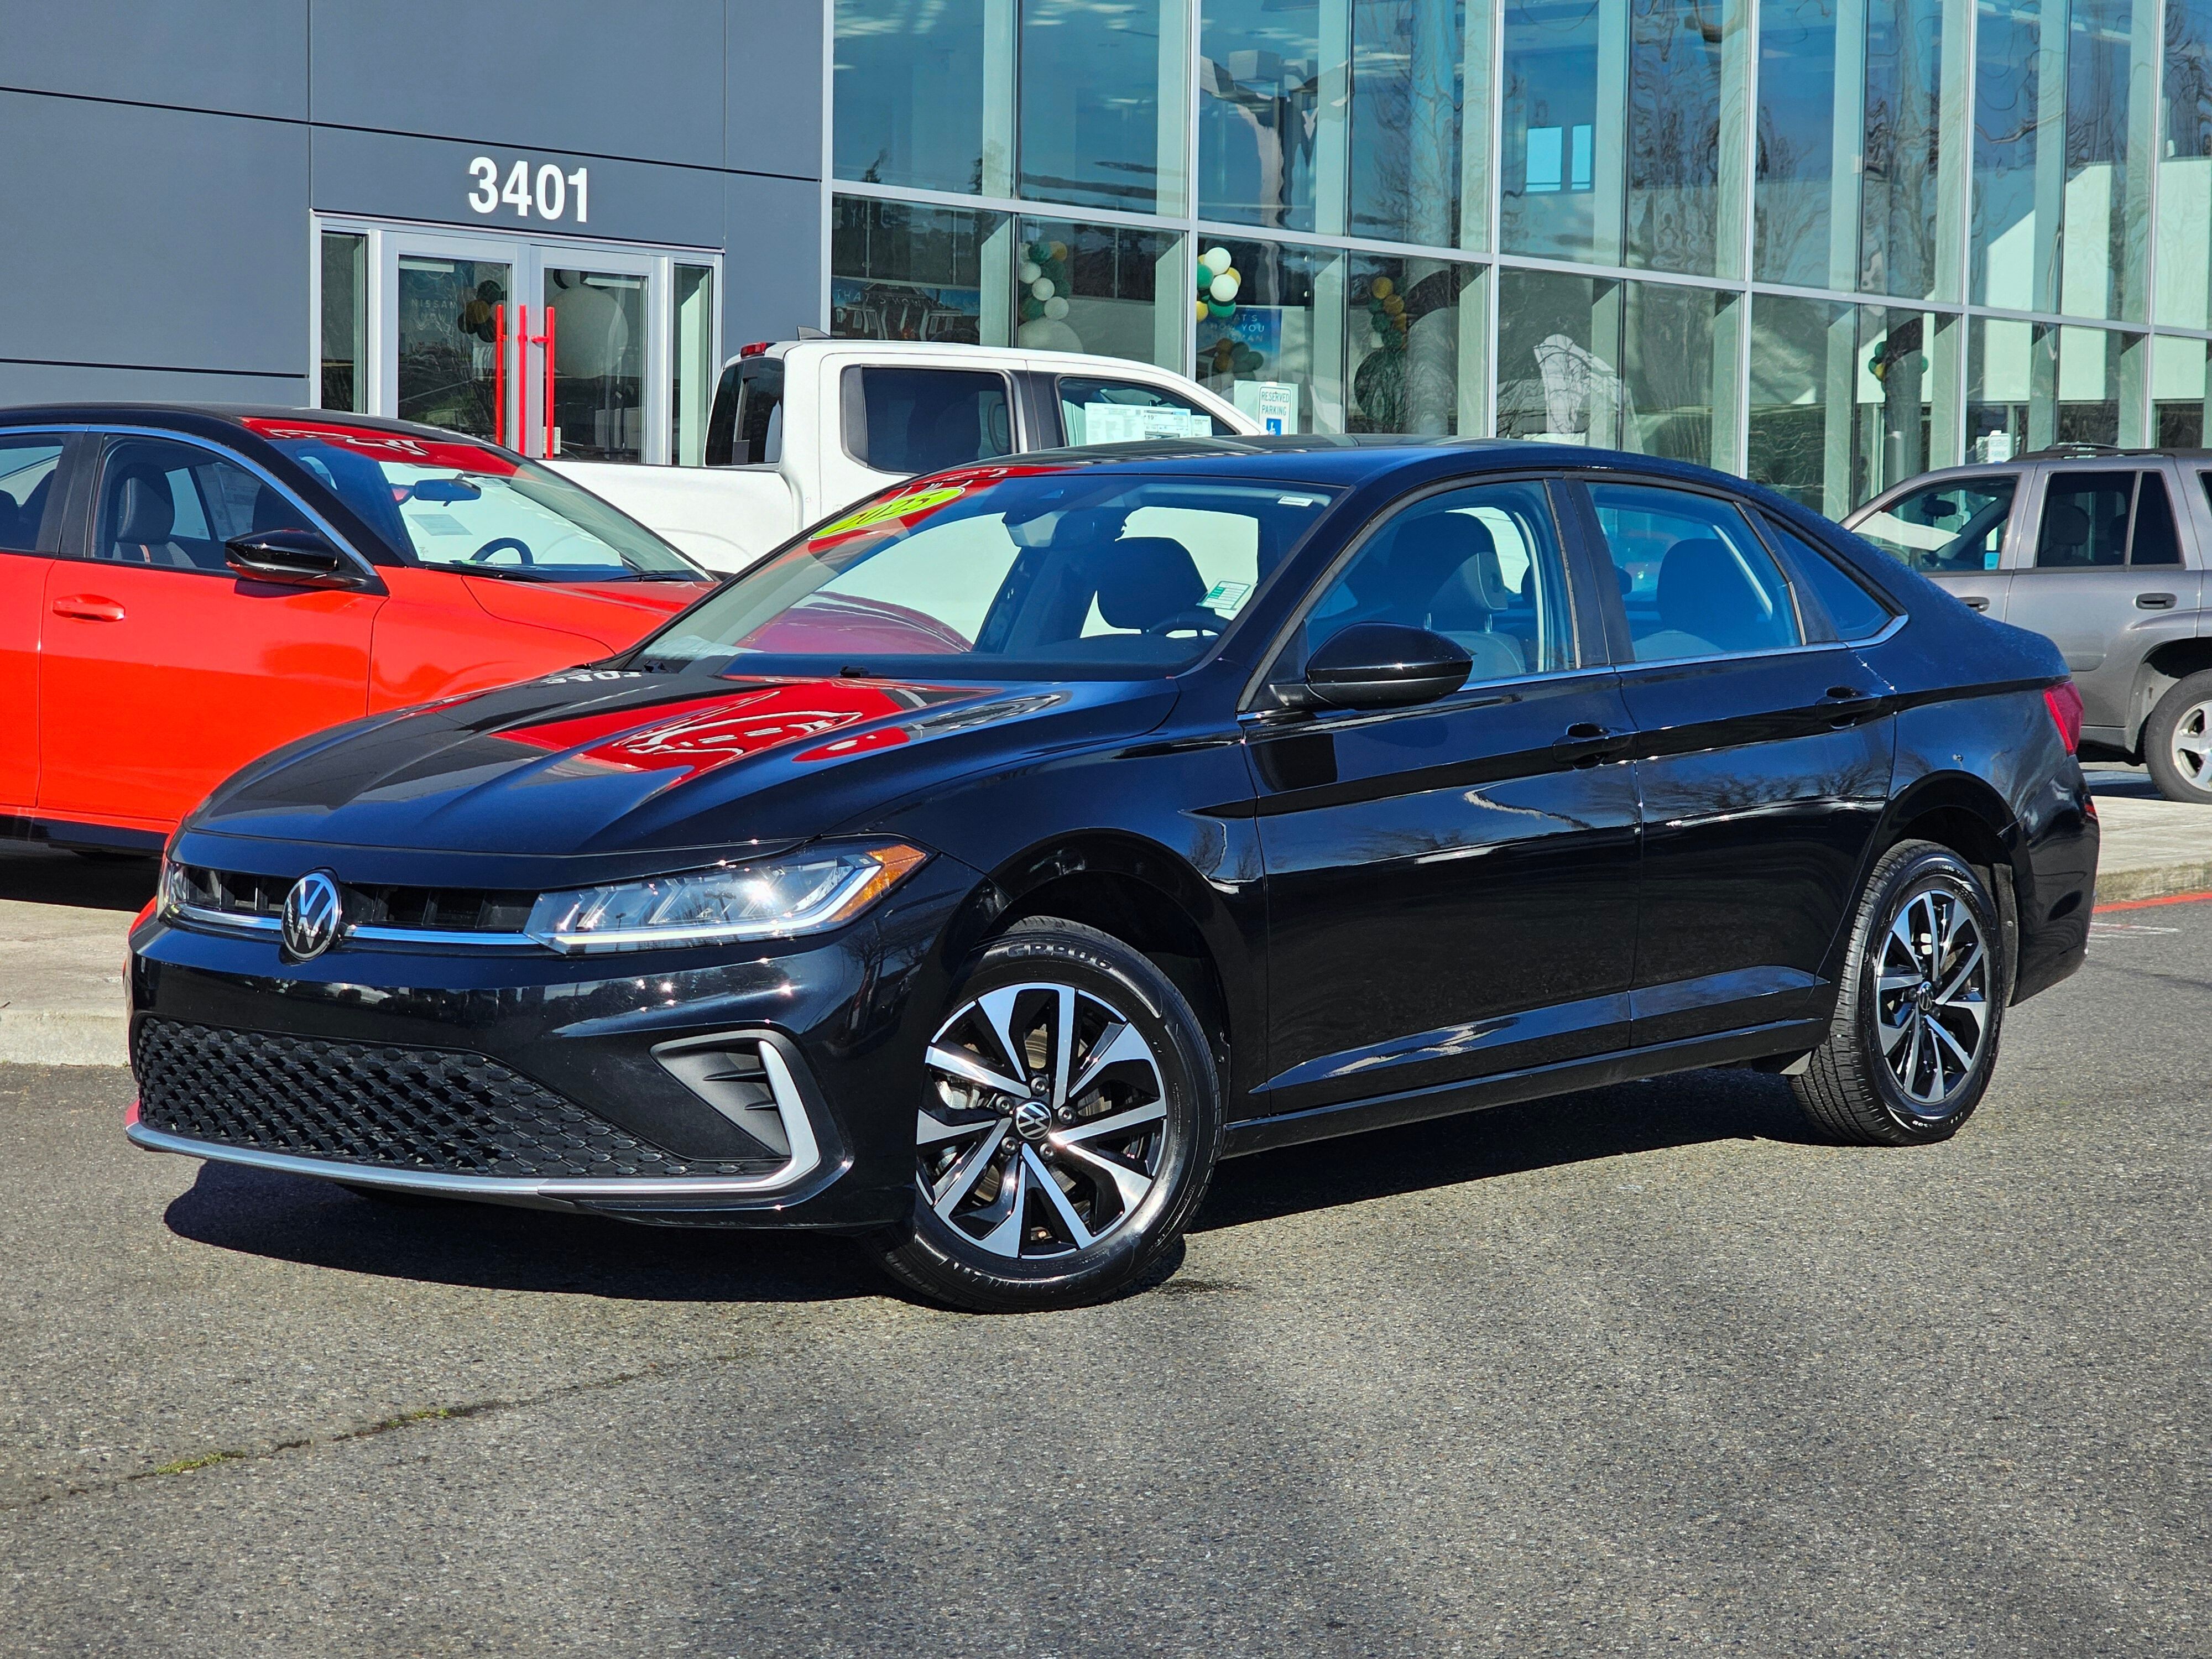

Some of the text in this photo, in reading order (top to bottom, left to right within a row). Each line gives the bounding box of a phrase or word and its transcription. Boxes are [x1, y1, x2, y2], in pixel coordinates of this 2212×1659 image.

[468, 156, 587, 222] 3401
[411, 299, 456, 309] NISSAN
[1241, 324, 1265, 332] YOU
[1261, 391, 1290, 403] RESERVED
[1261, 404, 1287, 416] PARKING
[828, 490, 945, 534] 2025
